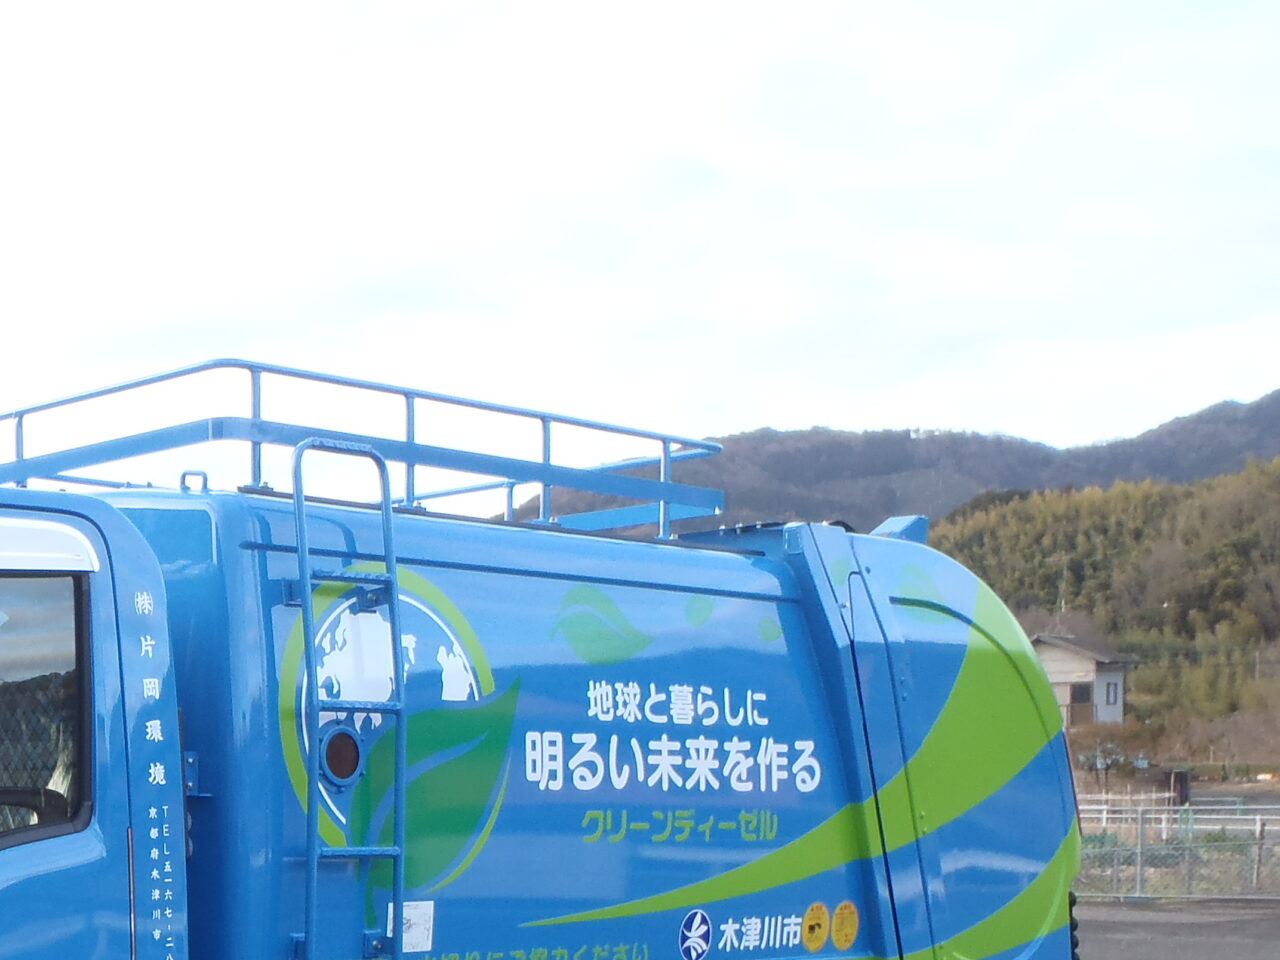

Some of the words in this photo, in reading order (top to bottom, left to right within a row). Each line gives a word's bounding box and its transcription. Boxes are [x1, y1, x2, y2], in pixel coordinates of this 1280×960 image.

[586, 679, 769, 727] 地球と暮らしに
[524, 730, 822, 793] 明るい未来を作る
[581, 808, 779, 842] クリーンディーゼル
[148, 805, 162, 941] 京都府木津川市
[717, 915, 803, 953] 木津川市
